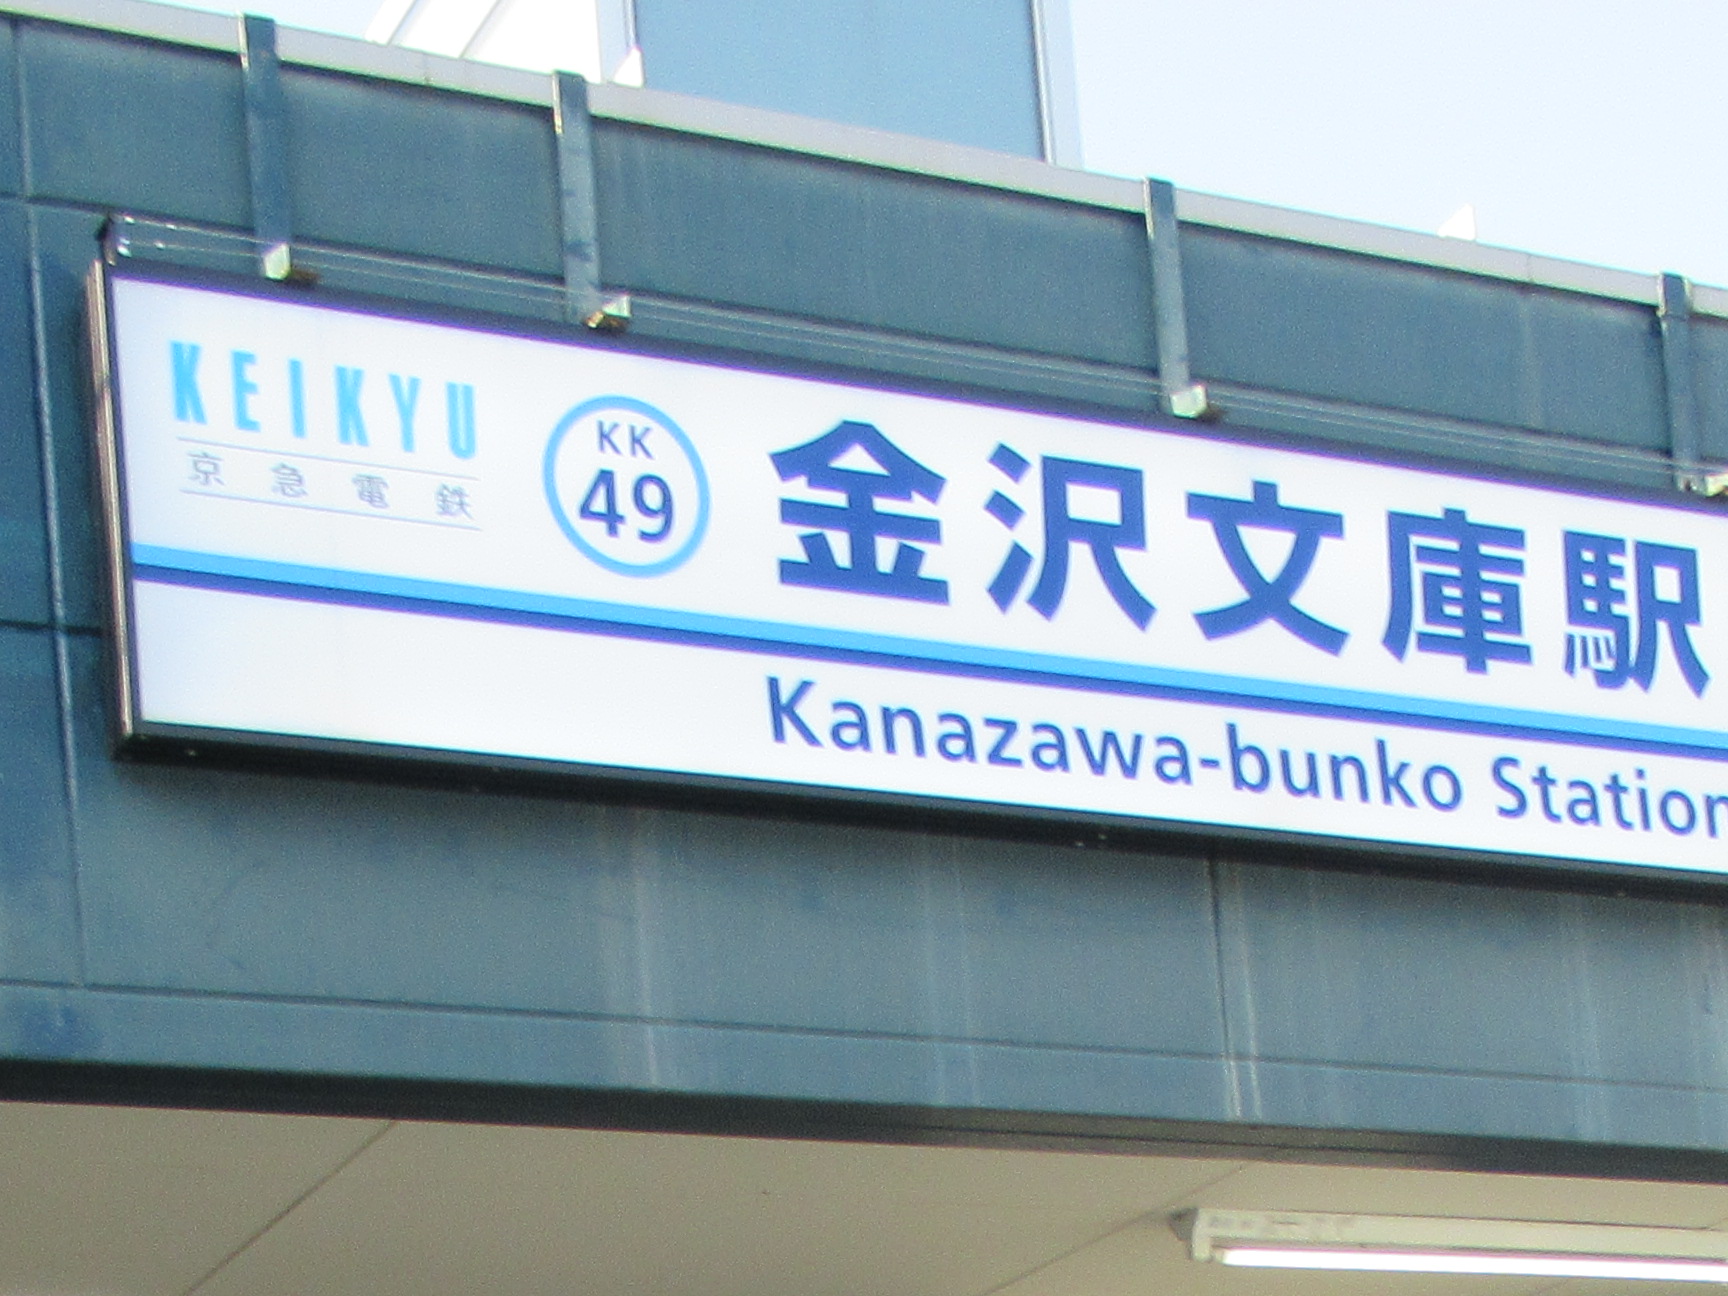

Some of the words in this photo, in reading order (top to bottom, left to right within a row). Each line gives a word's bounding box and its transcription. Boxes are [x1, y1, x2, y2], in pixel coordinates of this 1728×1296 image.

[171, 340, 477, 459] KEIKYU
[597, 420, 655, 459] KK
[188, 451, 473, 520] 京急電鉄
[579, 468, 674, 544] 49
[768, 419, 1710, 699] 金沢文庫駅
[766, 675, 1463, 812] Kanazawa-bunko
